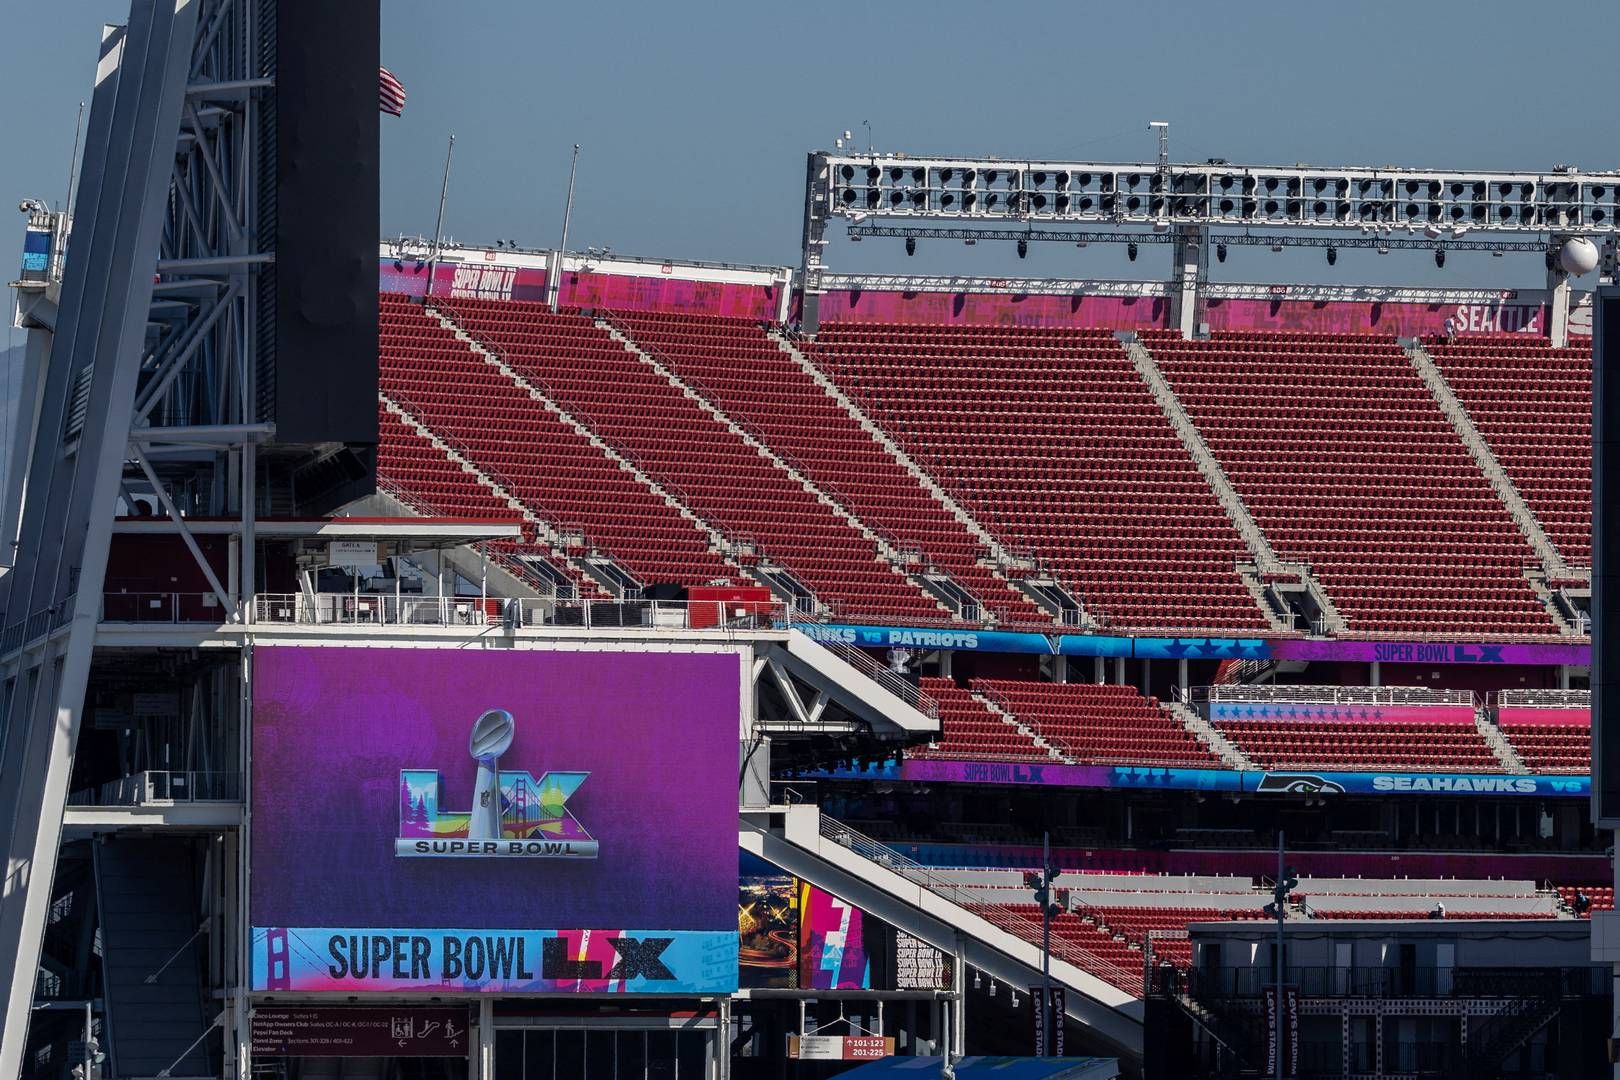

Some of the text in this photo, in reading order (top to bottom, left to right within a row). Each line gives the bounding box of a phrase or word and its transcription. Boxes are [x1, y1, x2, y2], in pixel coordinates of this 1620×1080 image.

[452, 269, 516, 292] SUPER BOWL LX
[1456, 306, 1540, 332] SEATTLE
[889, 631, 978, 648] PATRIOTS
[1374, 644, 1505, 662] SUPER BOWL LX
[964, 764, 1045, 782] SUPER BOWL LX
[1373, 776, 1536, 792] SEAHAWKS
[415, 841, 579, 855] SUPER BOWL
[897, 939, 917, 948] SUPER
[328, 934, 677, 980] SUPER BOWL LX
[897, 949, 917, 958] SUPER
[918, 949, 934, 958] BOWL
[897, 959, 917, 968] SUPER
[918, 959, 935, 968] BOWL
[897, 968, 917, 977] SUPER
[918, 969, 934, 977] BOWL
[897, 978, 918, 987] SUPER
[918, 978, 935, 987] BOWL
[1267, 1031, 1276, 1074] STADIUM
